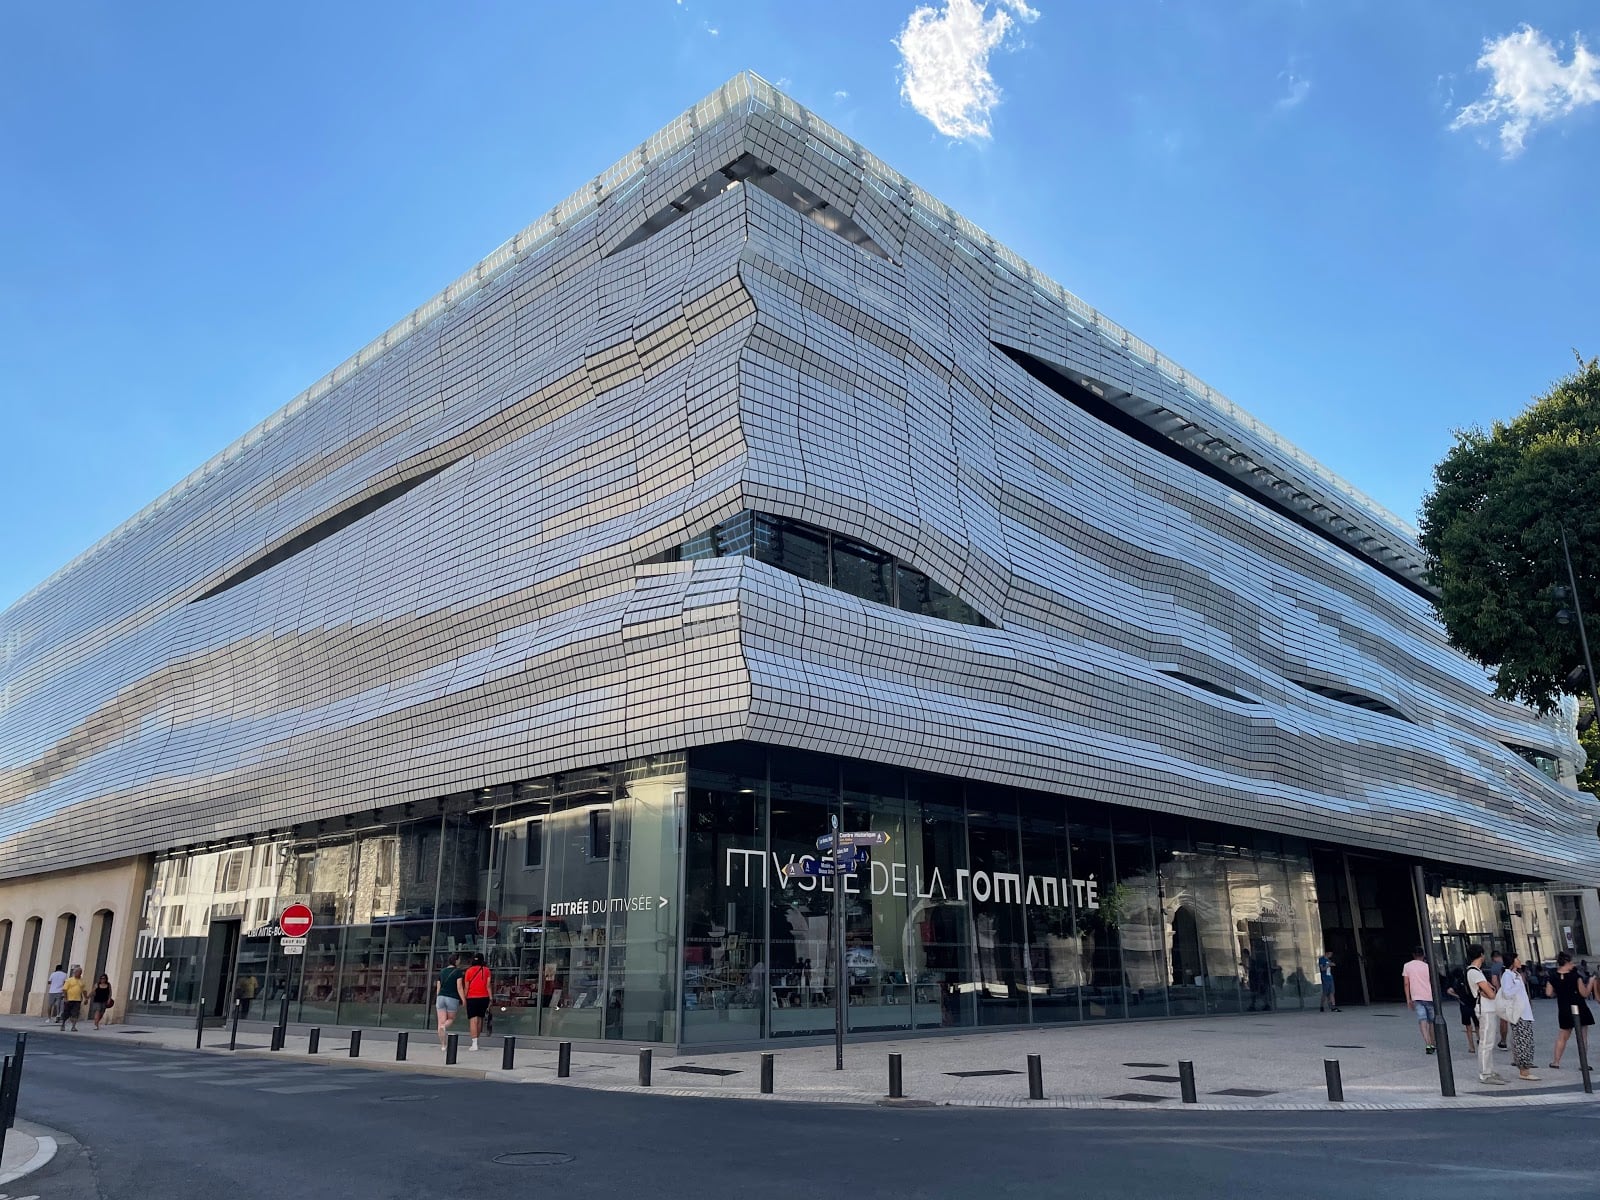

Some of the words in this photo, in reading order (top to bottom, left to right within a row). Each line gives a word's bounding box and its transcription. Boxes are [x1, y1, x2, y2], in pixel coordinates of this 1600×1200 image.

[871, 860, 908, 897] DE
[916, 865, 947, 899] LA
[550, 898, 589, 916] ENTRÉE
[592, 899, 607, 914] DU
[130, 962, 171, 1002] NITÉ
